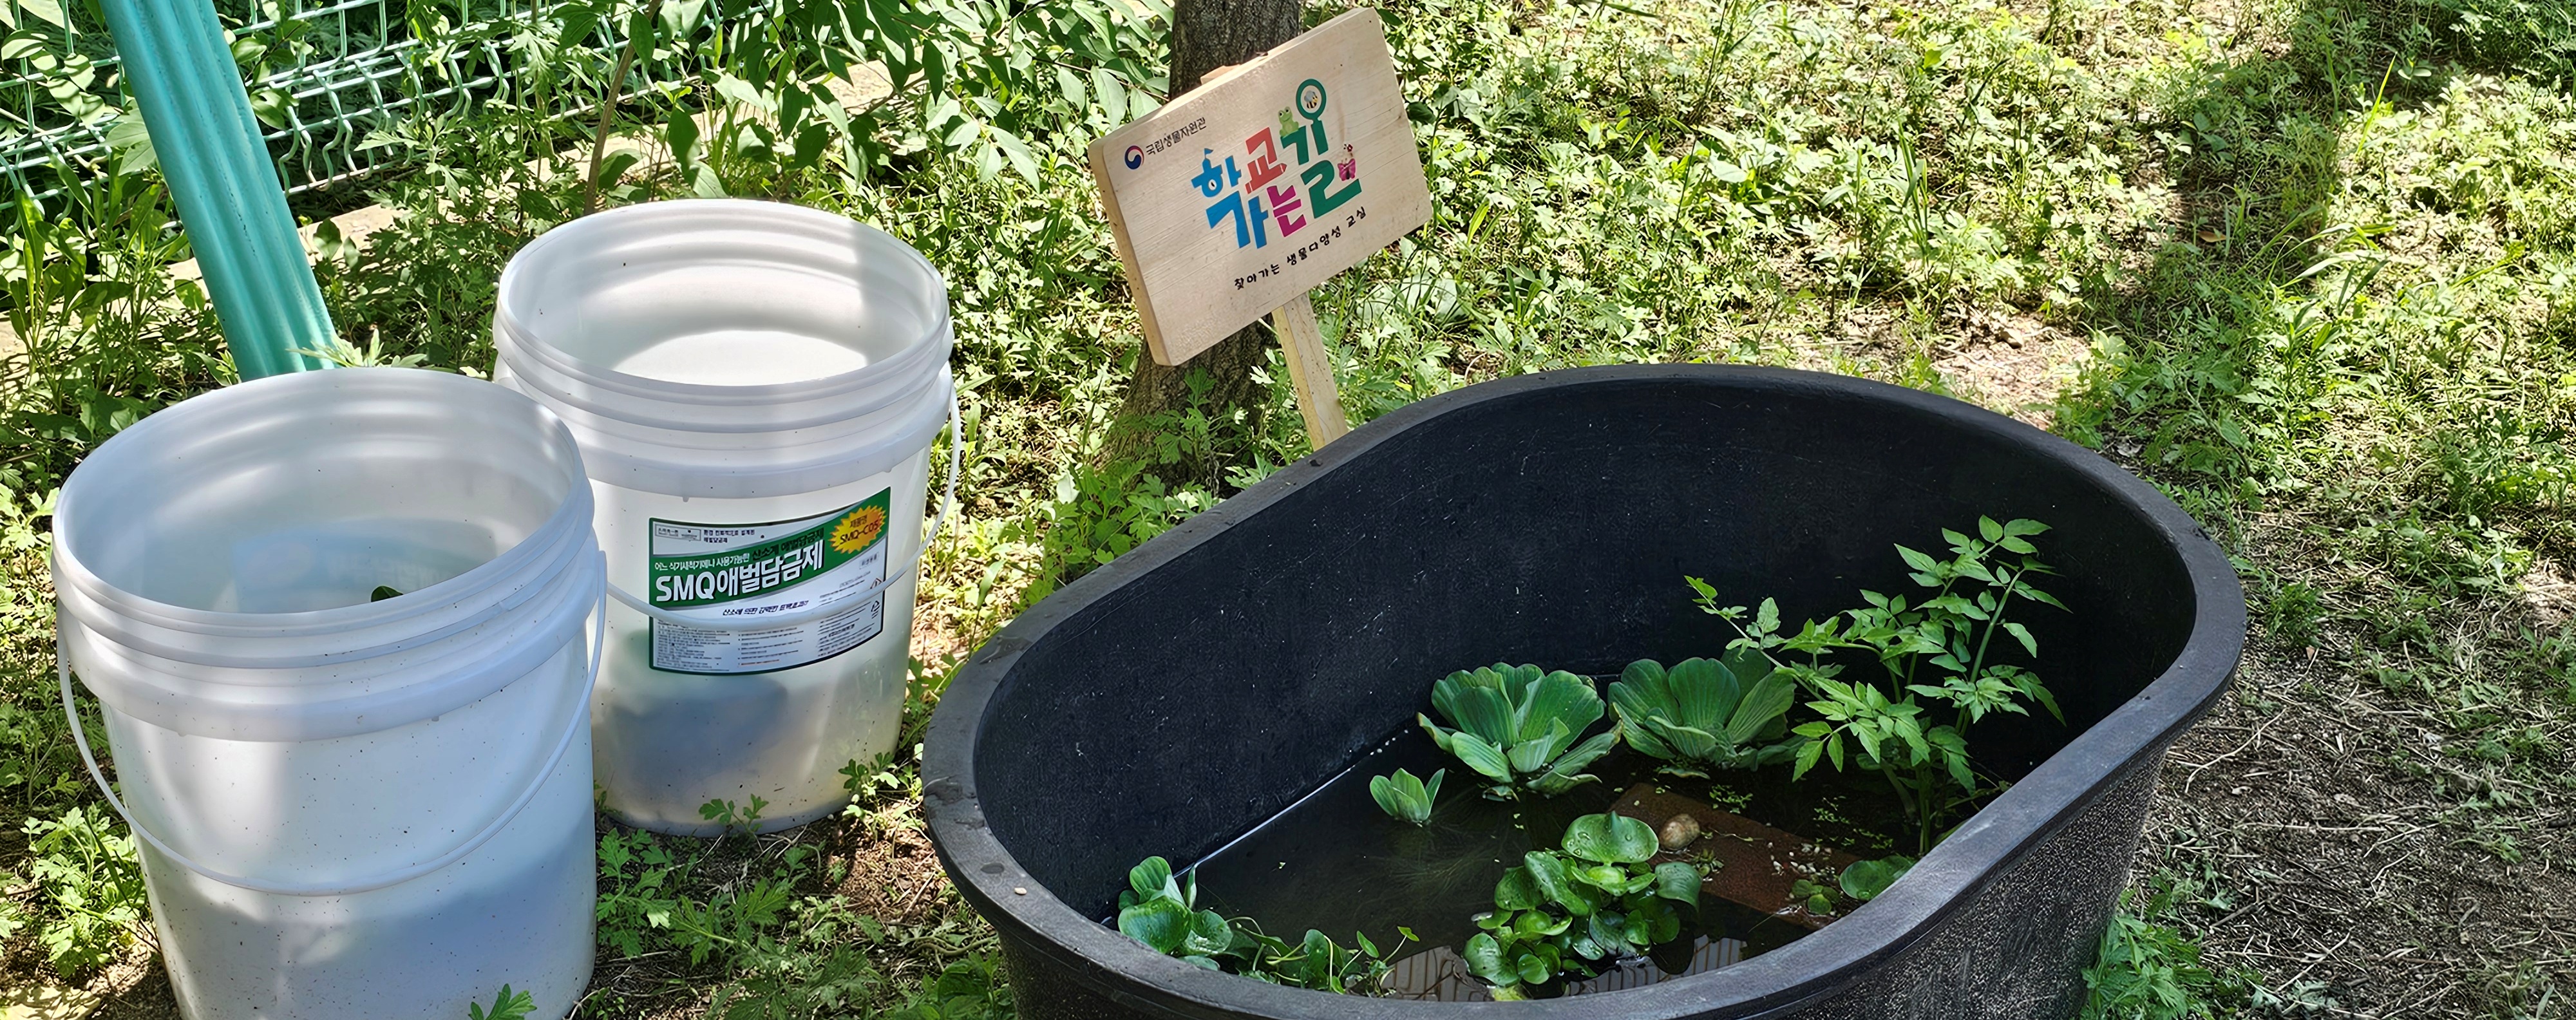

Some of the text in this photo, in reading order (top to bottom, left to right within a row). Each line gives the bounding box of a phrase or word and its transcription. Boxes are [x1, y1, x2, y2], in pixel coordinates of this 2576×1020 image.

[1145, 117, 1208, 156] 국립생물자원관
[1205, 184, 1307, 249] 가는
[1234, 206, 1367, 289] 찾아가는 생물다양성 교실
[752, 527, 825, 561] 산소계 애벌담금제
[839, 519, 880, 545] SMQ-C05
[654, 562, 668, 571] 어느
[715, 552, 750, 567] 사용가능한
[655, 539, 825, 602] SMQ애벌담금제
